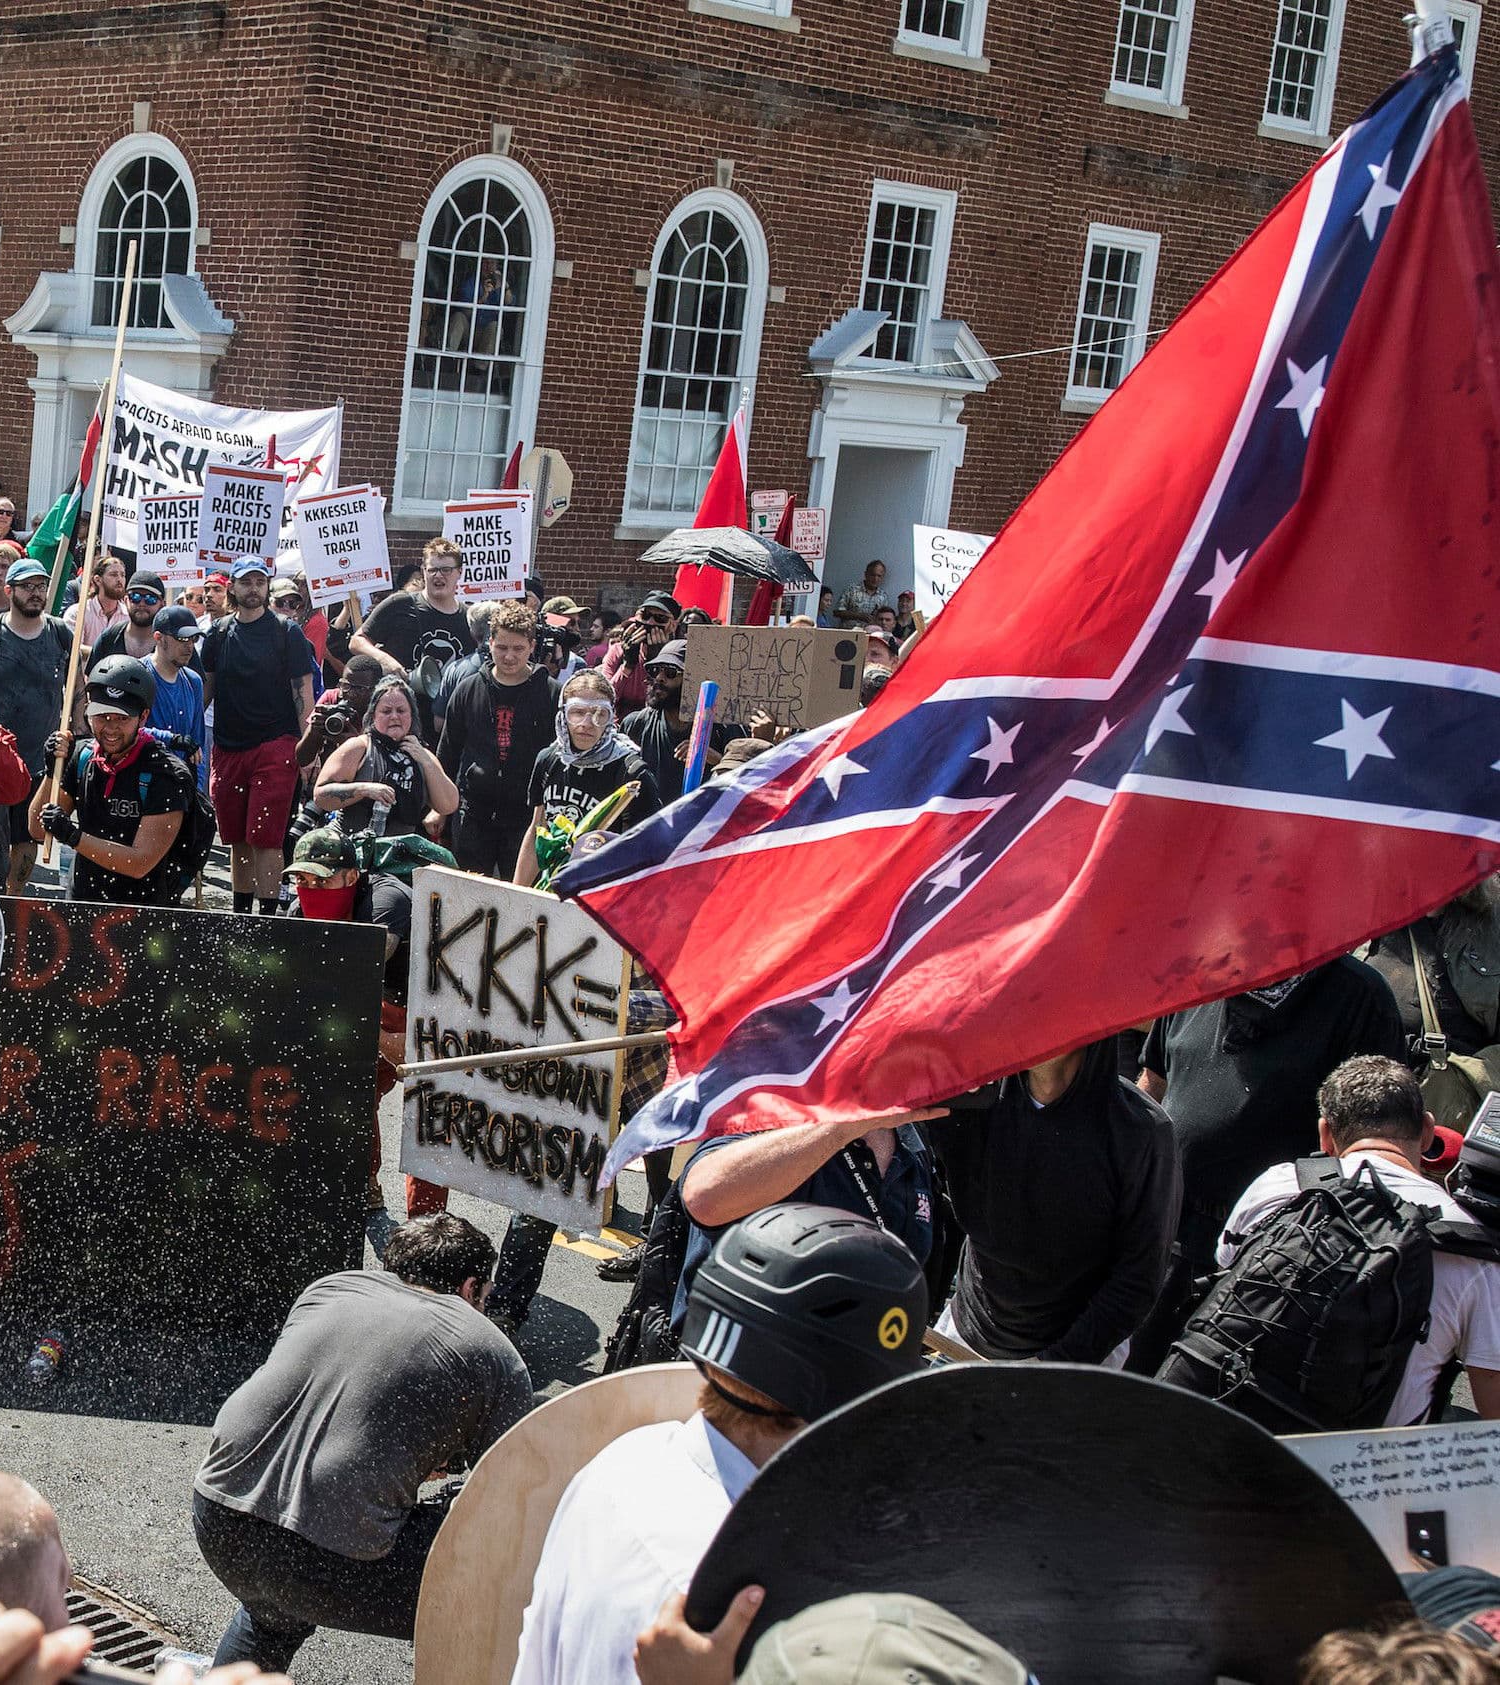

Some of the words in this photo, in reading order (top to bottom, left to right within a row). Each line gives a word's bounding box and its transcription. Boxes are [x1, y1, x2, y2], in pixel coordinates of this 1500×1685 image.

[171, 420, 212, 442] AFRAID
[113, 416, 209, 487] MASH
[105, 464, 168, 500] HITE
[224, 481, 265, 501] MAKE
[144, 500, 199, 521] SMASH
[212, 499, 272, 520] RACISTS
[304, 500, 367, 523] KKKESSLER
[797, 512, 806, 520] 30
[145, 520, 198, 542] WHITE
[213, 517, 268, 538] AFRAID
[318, 526, 330, 539] IS
[332, 520, 359, 537] NAZI
[463, 515, 503, 532] MAKE
[797, 520, 820, 528] LOADING
[214, 534, 262, 554] AGAIN
[323, 538, 361, 556] TRASH
[455, 531, 512, 548] RACISTS
[794, 543, 823, 551] MON-SAT
[931, 535, 982, 557] Gener
[461, 549, 511, 566] AFRAID
[463, 565, 508, 582] AGAIN
[728, 632, 813, 674] BLACK
[734, 672, 805, 699] LIVES
[95, 1046, 300, 1145] RACE
[405, 1079, 608, 1204] TERRORISM
